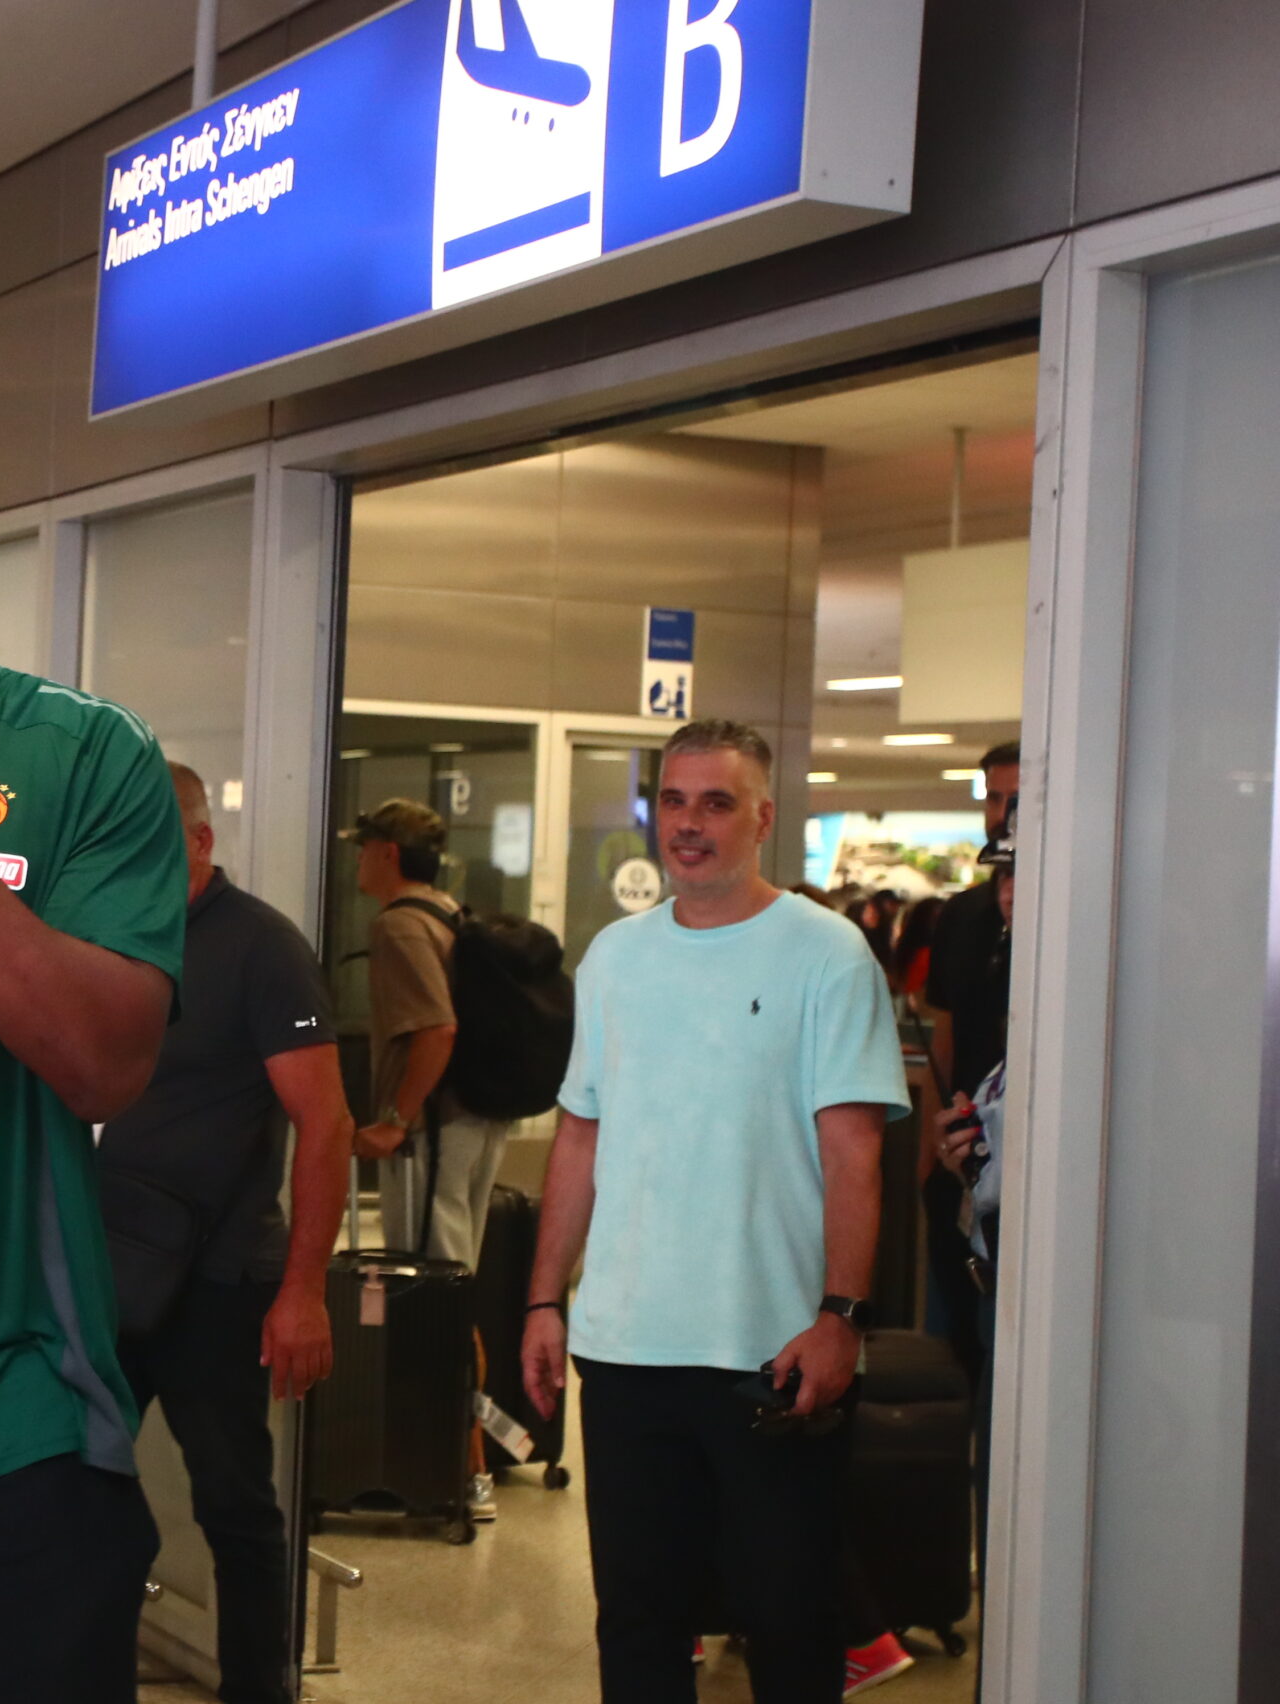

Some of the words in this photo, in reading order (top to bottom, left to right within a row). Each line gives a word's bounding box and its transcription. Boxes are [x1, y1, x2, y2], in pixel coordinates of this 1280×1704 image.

[169, 123, 220, 181] Εντός
[221, 88, 300, 157] Σένγκεν
[659, 0, 742, 178] B
[105, 210, 163, 270] Arrivals
[164, 199, 203, 244] Intra
[205, 158, 294, 226] Schengen
